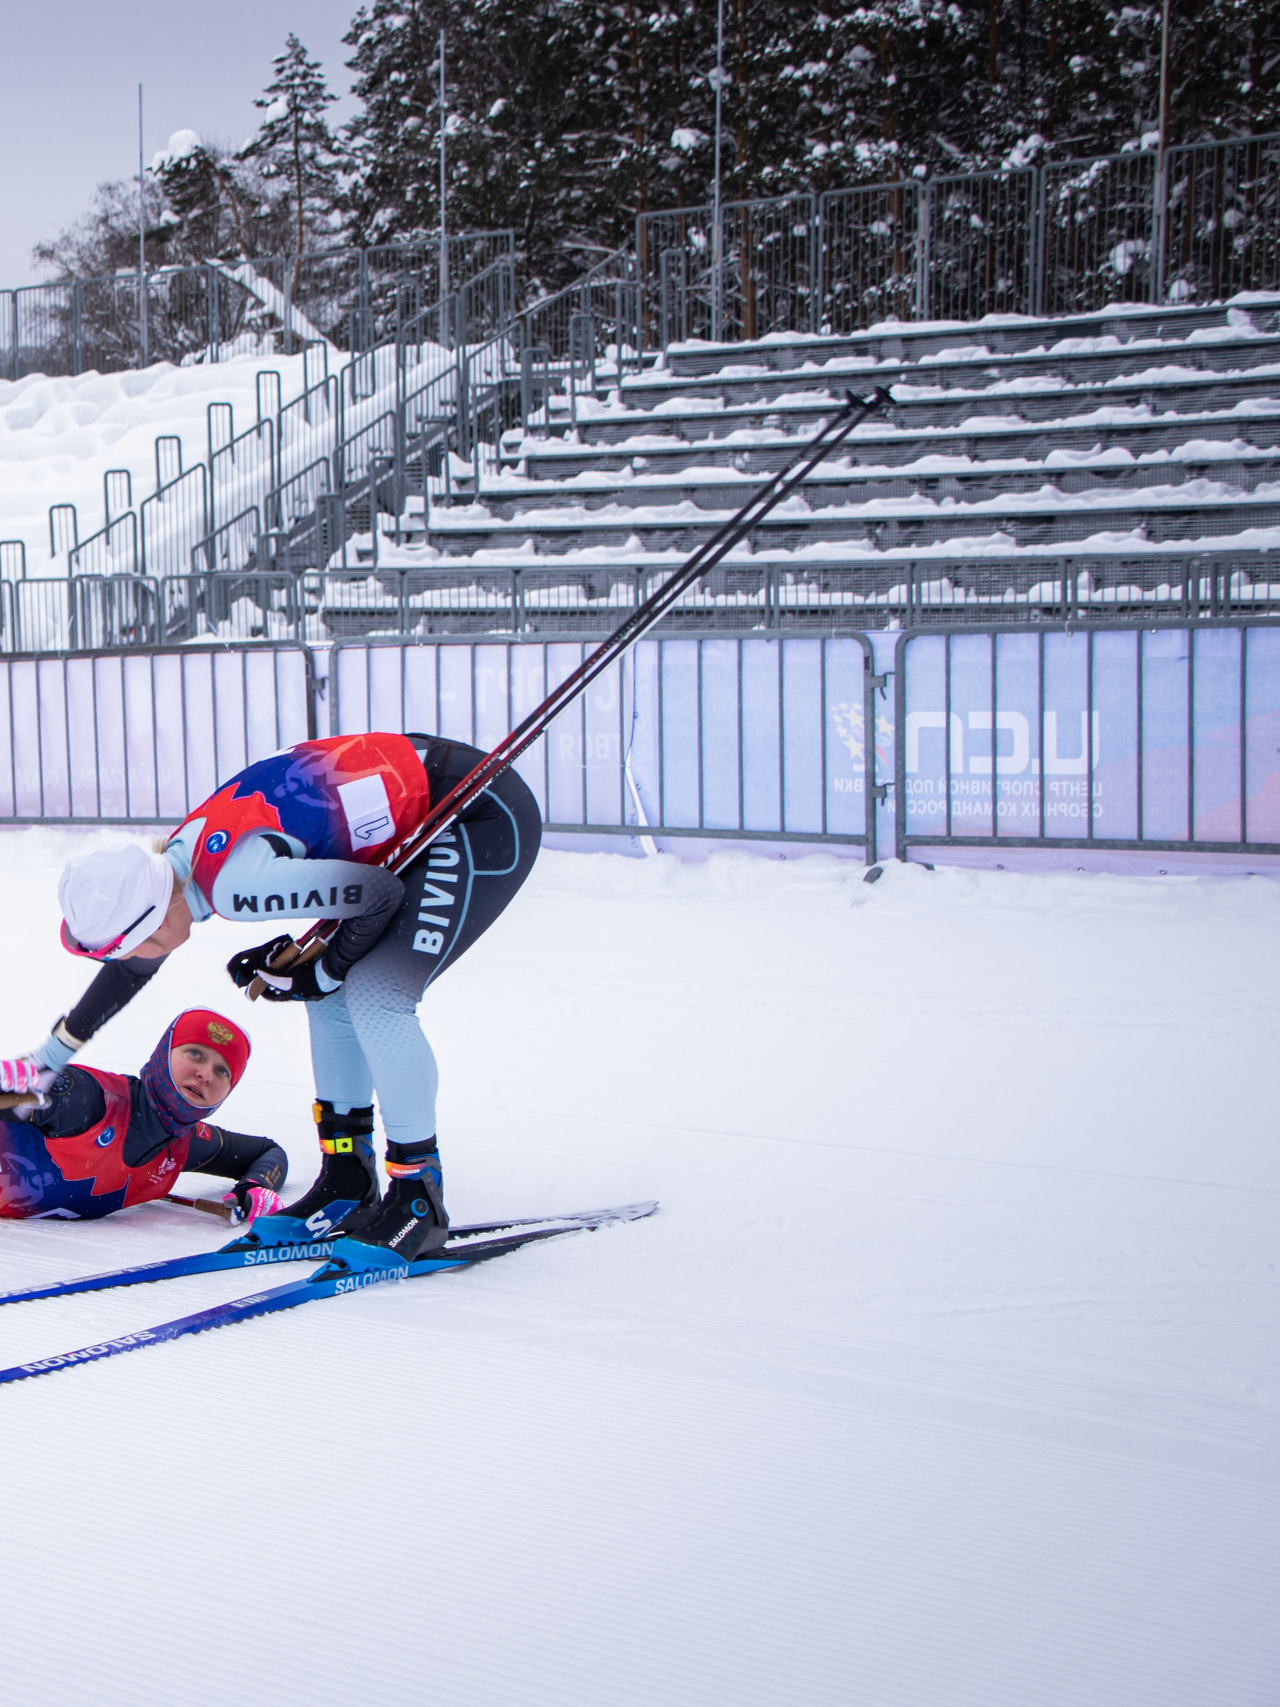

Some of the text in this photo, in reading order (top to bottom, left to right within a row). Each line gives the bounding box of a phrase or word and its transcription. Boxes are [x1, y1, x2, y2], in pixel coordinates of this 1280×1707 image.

[233, 883, 364, 914] BIVIUM
[388, 1217, 419, 1248] SALOMON
[243, 1241, 335, 1266] SALOMON
[334, 1265, 410, 1295] SALOMON
[20, 1330, 157, 1374] SALOMON
